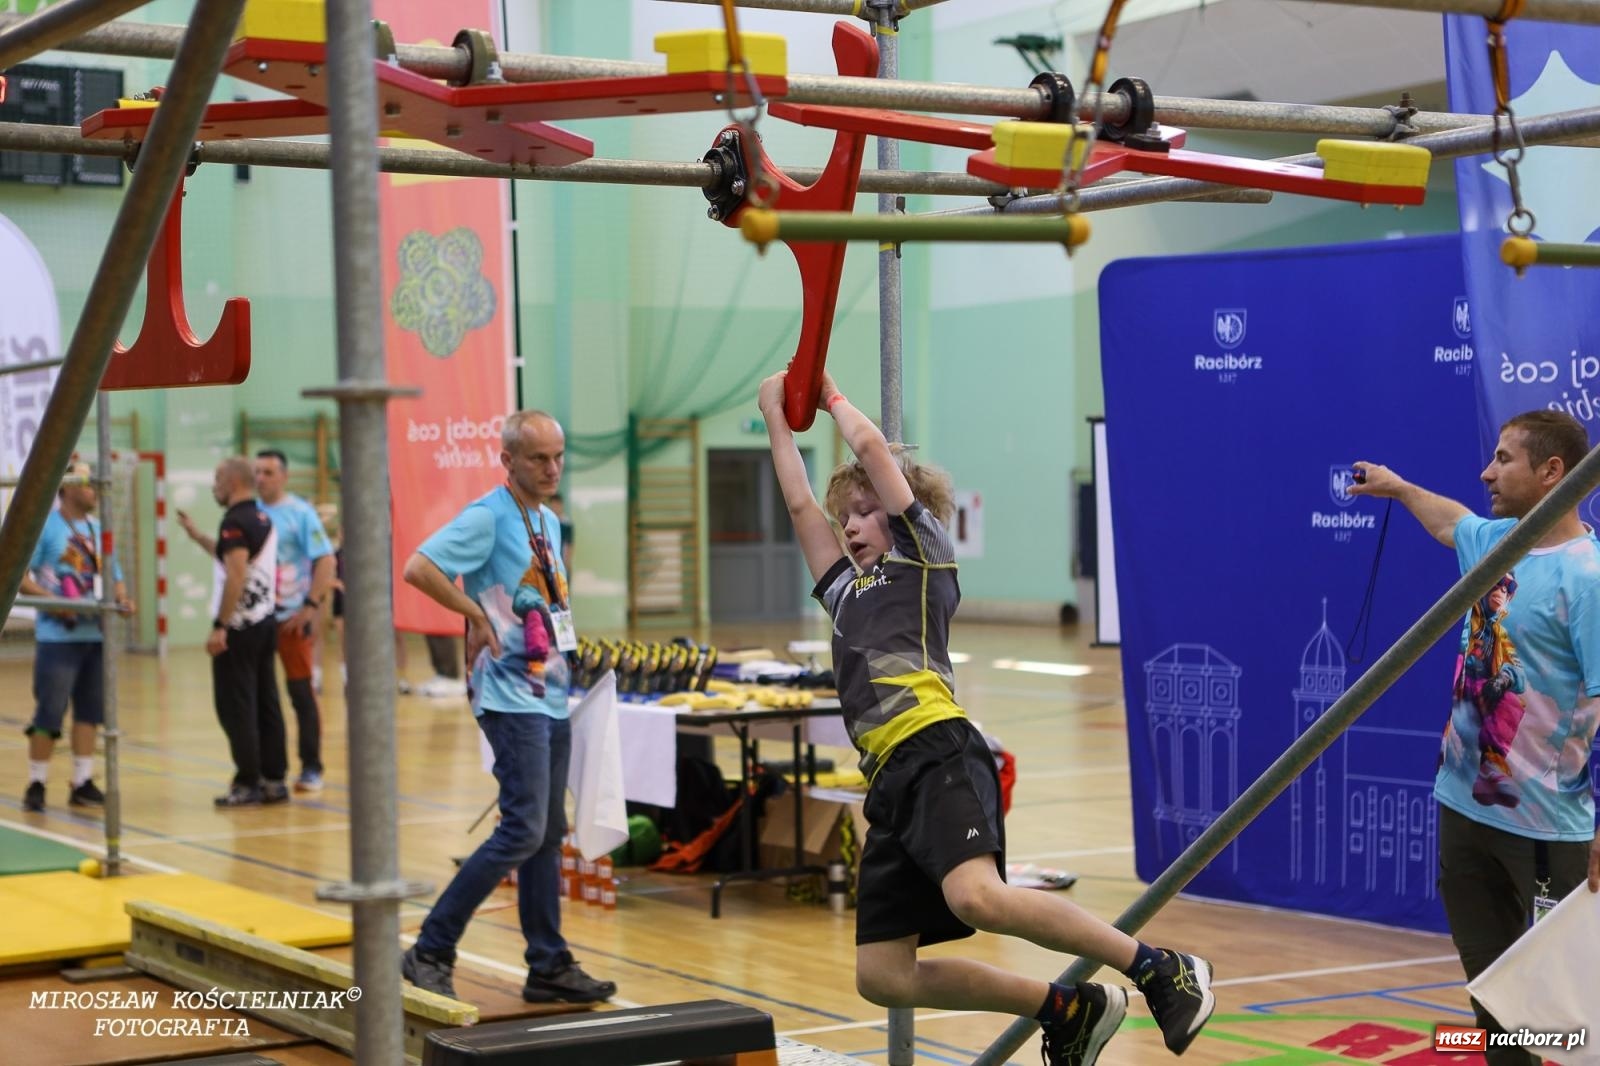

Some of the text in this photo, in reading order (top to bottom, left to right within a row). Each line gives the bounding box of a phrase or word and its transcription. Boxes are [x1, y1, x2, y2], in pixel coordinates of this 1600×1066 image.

[1194, 352, 1263, 370] Racibórz
[1434, 343, 1473, 362] Racib
[1312, 511, 1375, 528] Racibórz
